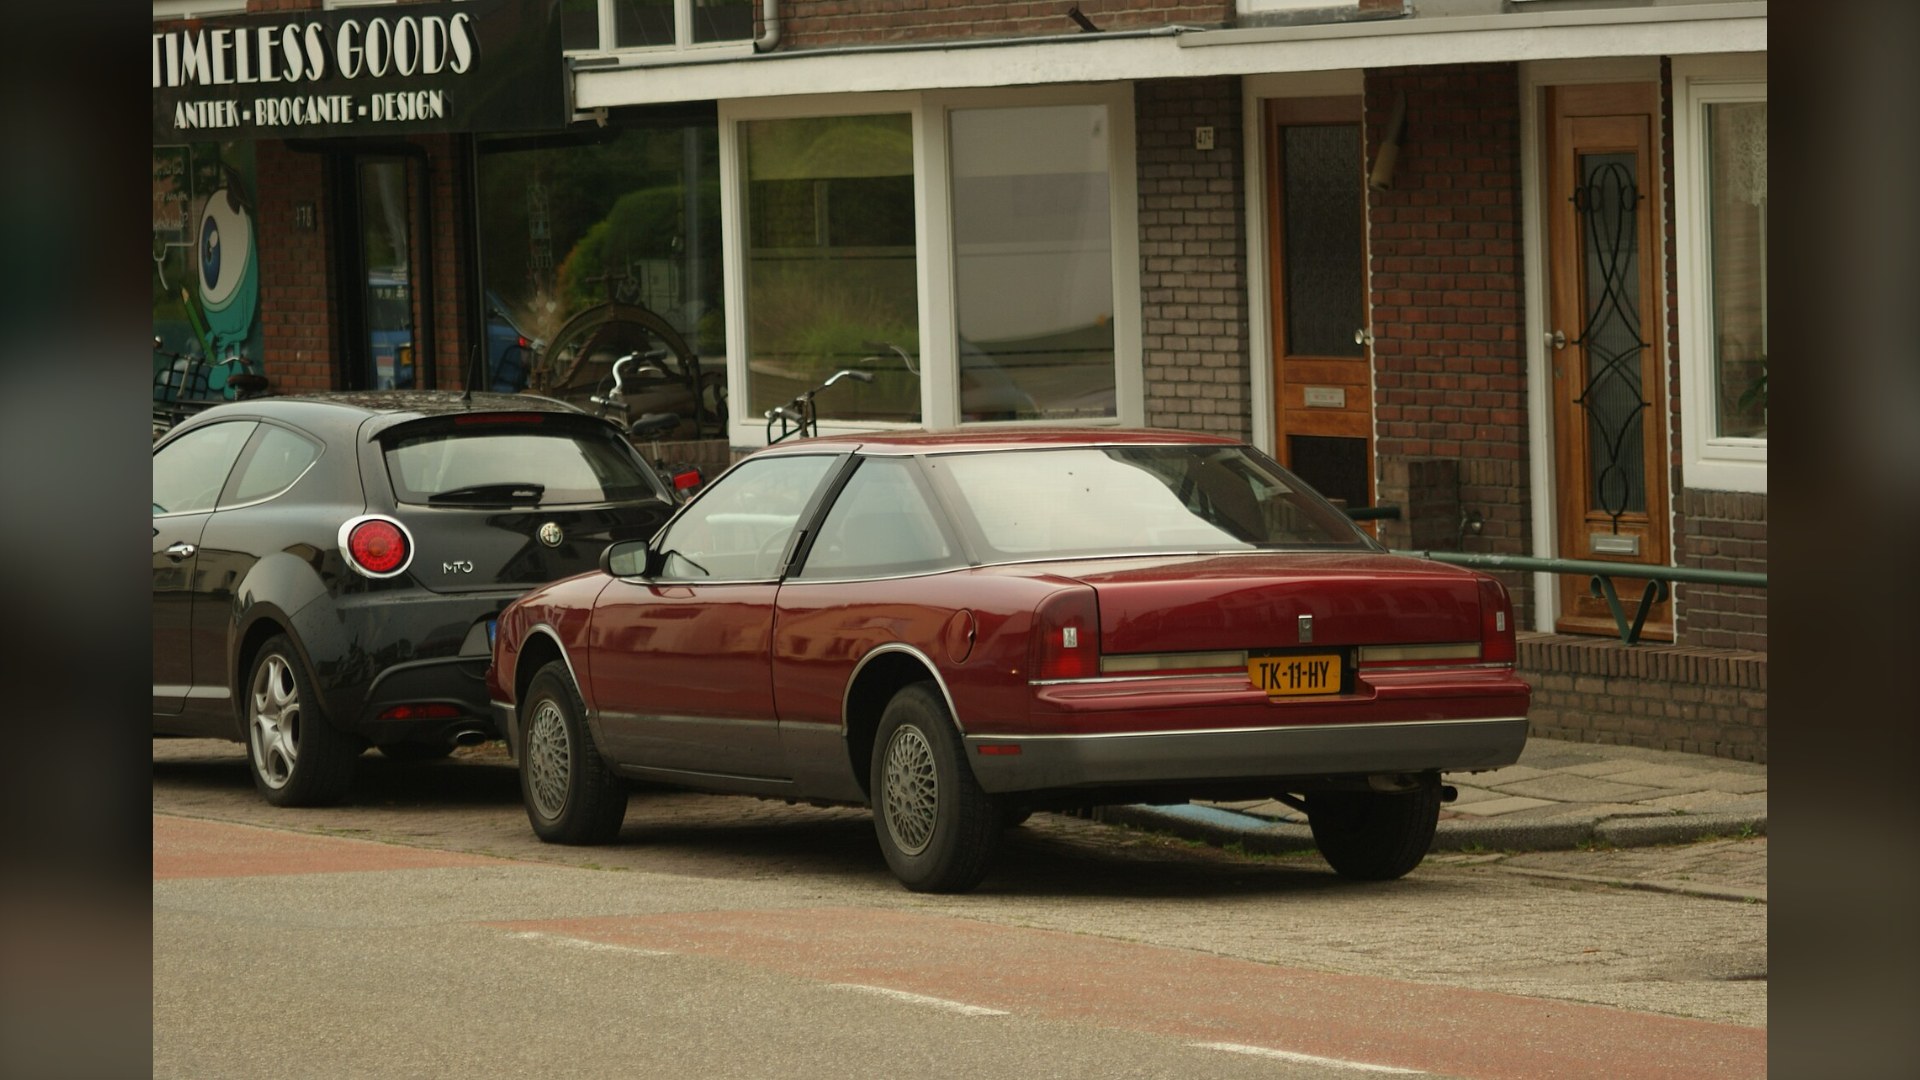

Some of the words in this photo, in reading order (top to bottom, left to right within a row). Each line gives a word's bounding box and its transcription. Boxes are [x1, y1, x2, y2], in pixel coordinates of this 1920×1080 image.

[337, 12, 471, 79] GOODS
[174, 100, 240, 129] ANTIEK
[255, 95, 353, 126] BROCANTE
[372, 90, 444, 122] DESIGN
[1259, 660, 1330, 690] TK-11-HY
